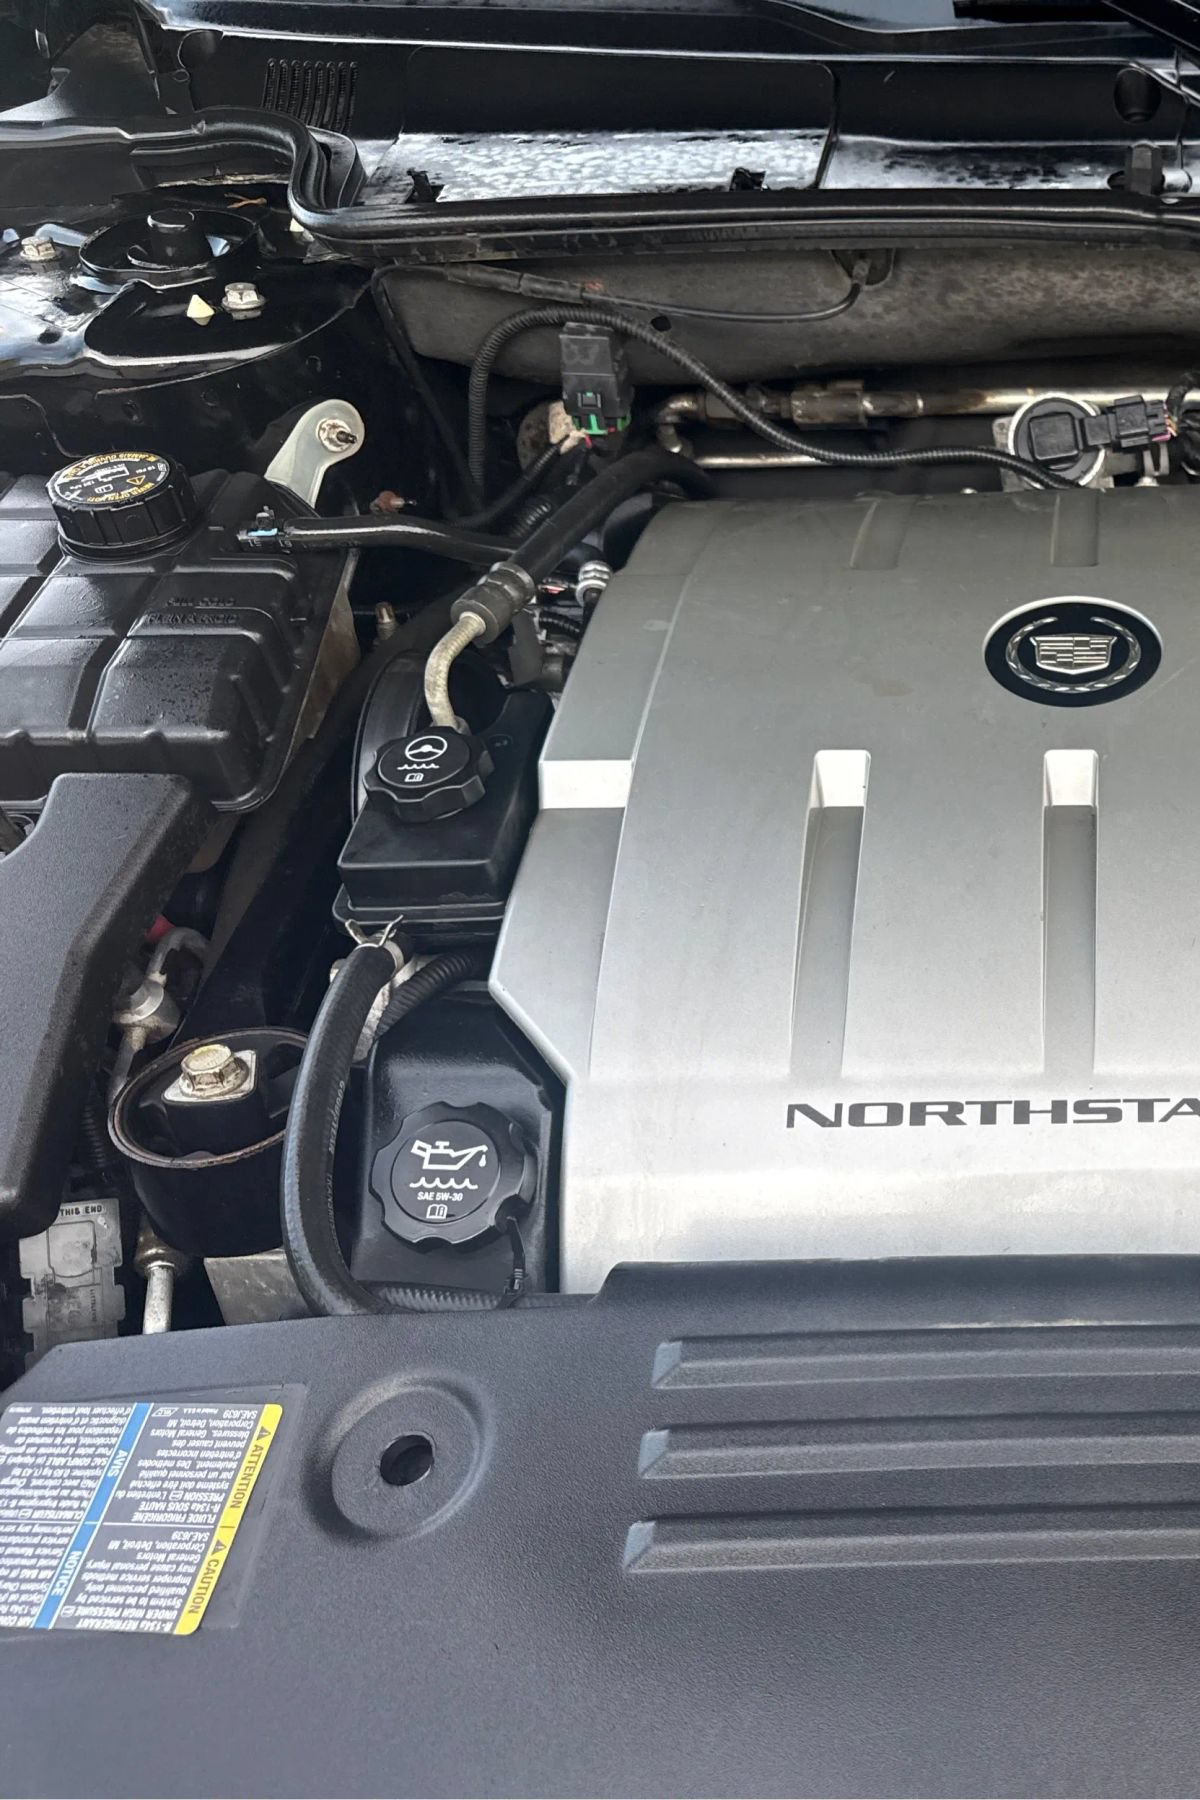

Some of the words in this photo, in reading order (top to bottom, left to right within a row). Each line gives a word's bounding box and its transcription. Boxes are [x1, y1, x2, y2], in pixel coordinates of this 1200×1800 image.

[417, 1192, 435, 1200] SAE
[436, 1192, 463, 1201] 5W-30
[60, 1207, 80, 1217] THIS
[84, 1205, 102, 1214] END
[223, 1410, 258, 1419] SAEJ639
[166, 1420, 178, 1428] MI
[6, 1426, 18, 1434] de
[150, 1428, 177, 1437] Motors
[178, 1429, 207, 1438] General
[172, 1440, 186, 1448] des
[214, 1439, 247, 1448] peuvent
[156, 1449, 199, 1458] incorrectes
[91, 1458, 109, 1466] SAC
[107, 1449, 128, 1477] AVIS
[137, 1459, 175, 1468] méthodes
[179, 1460, 192, 1468] Des
[139, 1470, 168, 1478] qualifié
[168, 1470, 208, 1478] personnel
[218, 1470, 235, 1478] par
[230, 1444, 264, 1509] ATTENTION
[162, 1481, 179, 1489] être
[180, 1481, 195, 1490] doit
[196, 1480, 230, 1490] système
[115, 1490, 126, 1498] du
[184, 1492, 225, 1500] PRESSION
[138, 1501, 167, 1510] HAUTE
[167, 1502, 190, 1511] SOUS
[191, 1502, 221, 1512] R-134a
[187, 1514, 216, 1524] FLUIDE
[40, 1536, 70, 1545] service
[171, 1531, 210, 1541] SAEJ639
[108, 1540, 121, 1549] MI
[5, 1547, 34, 1556] Manual
[35, 1547, 65, 1557] Service
[136, 1552, 166, 1561] Motors
[167, 1553, 200, 1563] General
[112, 1562, 150, 1571] personal
[150, 1564, 176, 1572] cause
[176, 1563, 196, 1573] may
[51, 1551, 82, 1596] NOTICE
[81, 1572, 119, 1581] methods
[119, 1574, 151, 1582] service
[151, 1575, 192, 1585] Improper
[105, 1583, 149, 1593] personnel
[148, 1585, 187, 1595] qualified
[188, 1559, 219, 1615] CAUTION
[74, 1593, 88, 1603] by
[88, 1595, 125, 1605] serviced
[127, 1596, 138, 1605] be
[139, 1597, 149, 1606] to
[149, 1597, 182, 1608] System
[74, 1607, 122, 1617] PRESSURE
[123, 1608, 145, 1617] HIGH
[147, 1609, 177, 1619] UNDER
[17, 1617, 33, 1626] AIR
[75, 1618, 139, 1630] REFRIGERANT
[140, 1621, 173, 1631] R-134a
